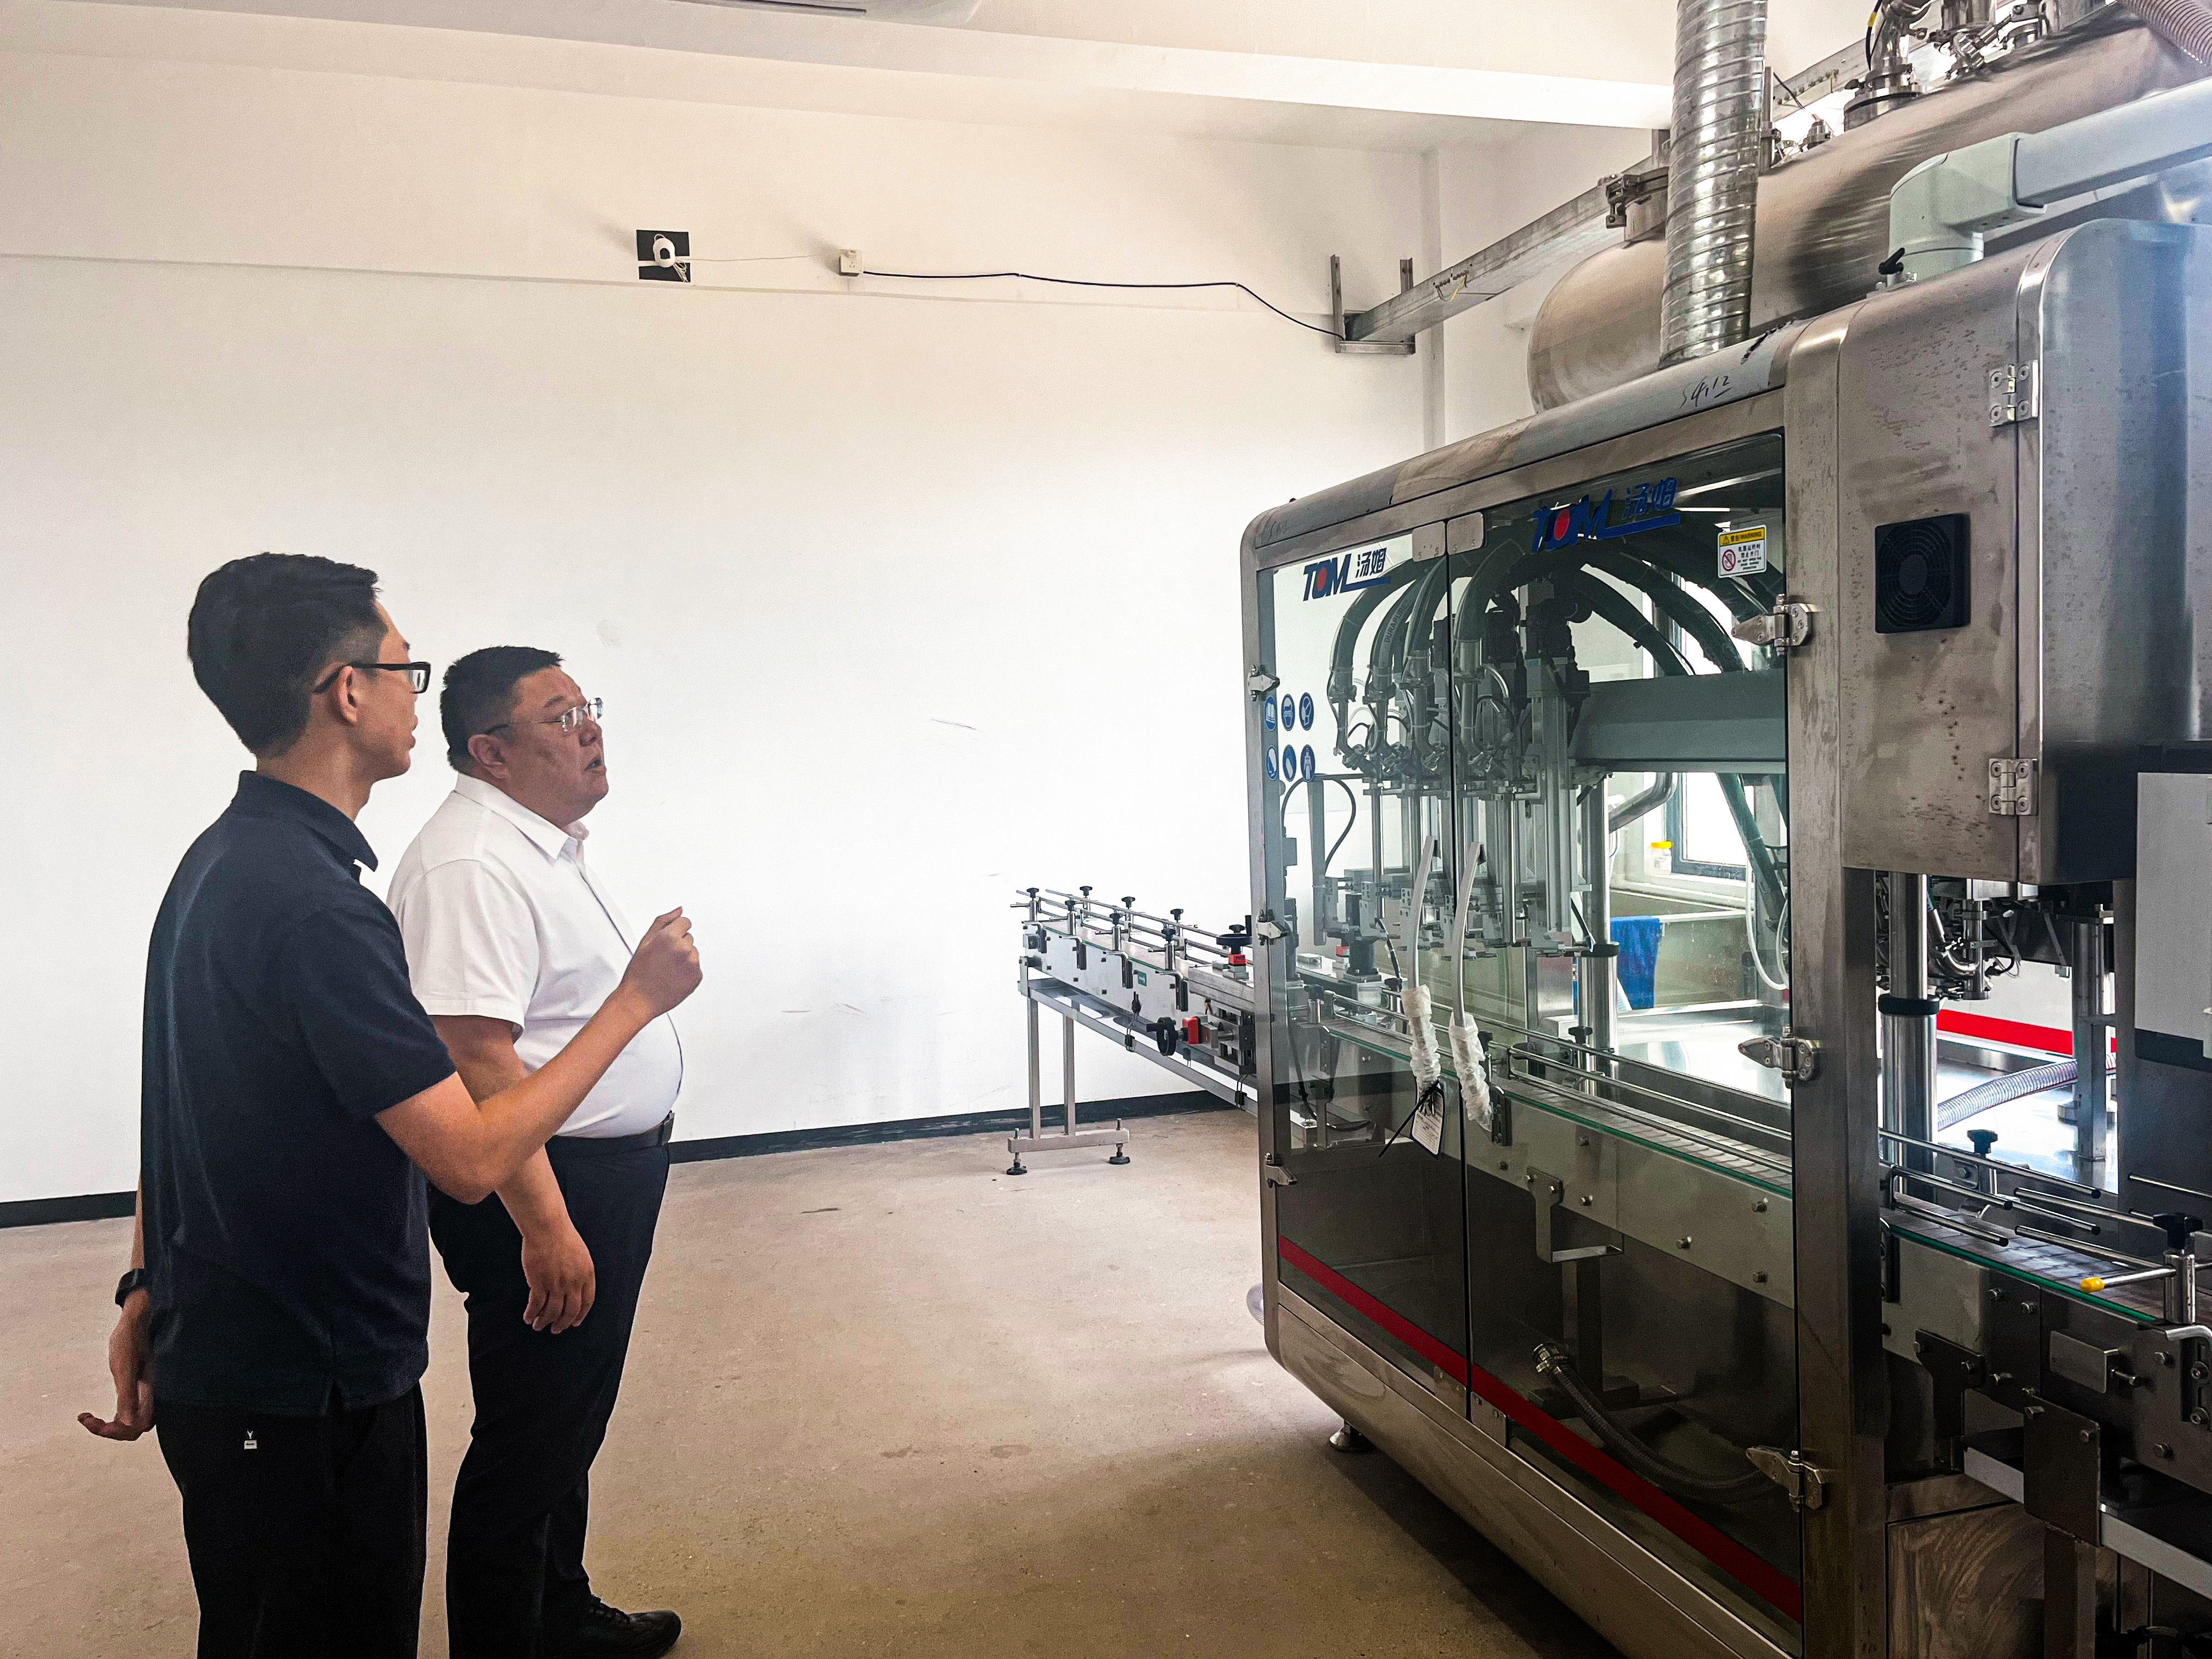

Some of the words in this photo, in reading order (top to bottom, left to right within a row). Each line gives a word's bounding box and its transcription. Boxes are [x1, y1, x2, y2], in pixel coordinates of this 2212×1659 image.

[1531, 488, 1613, 554] TOM
[1622, 477, 1678, 520] 汤姆
[1303, 553, 1352, 602] TOM
[1356, 548, 1387, 578] 汤姆
[1384, 603, 1408, 643] DURAPURE
